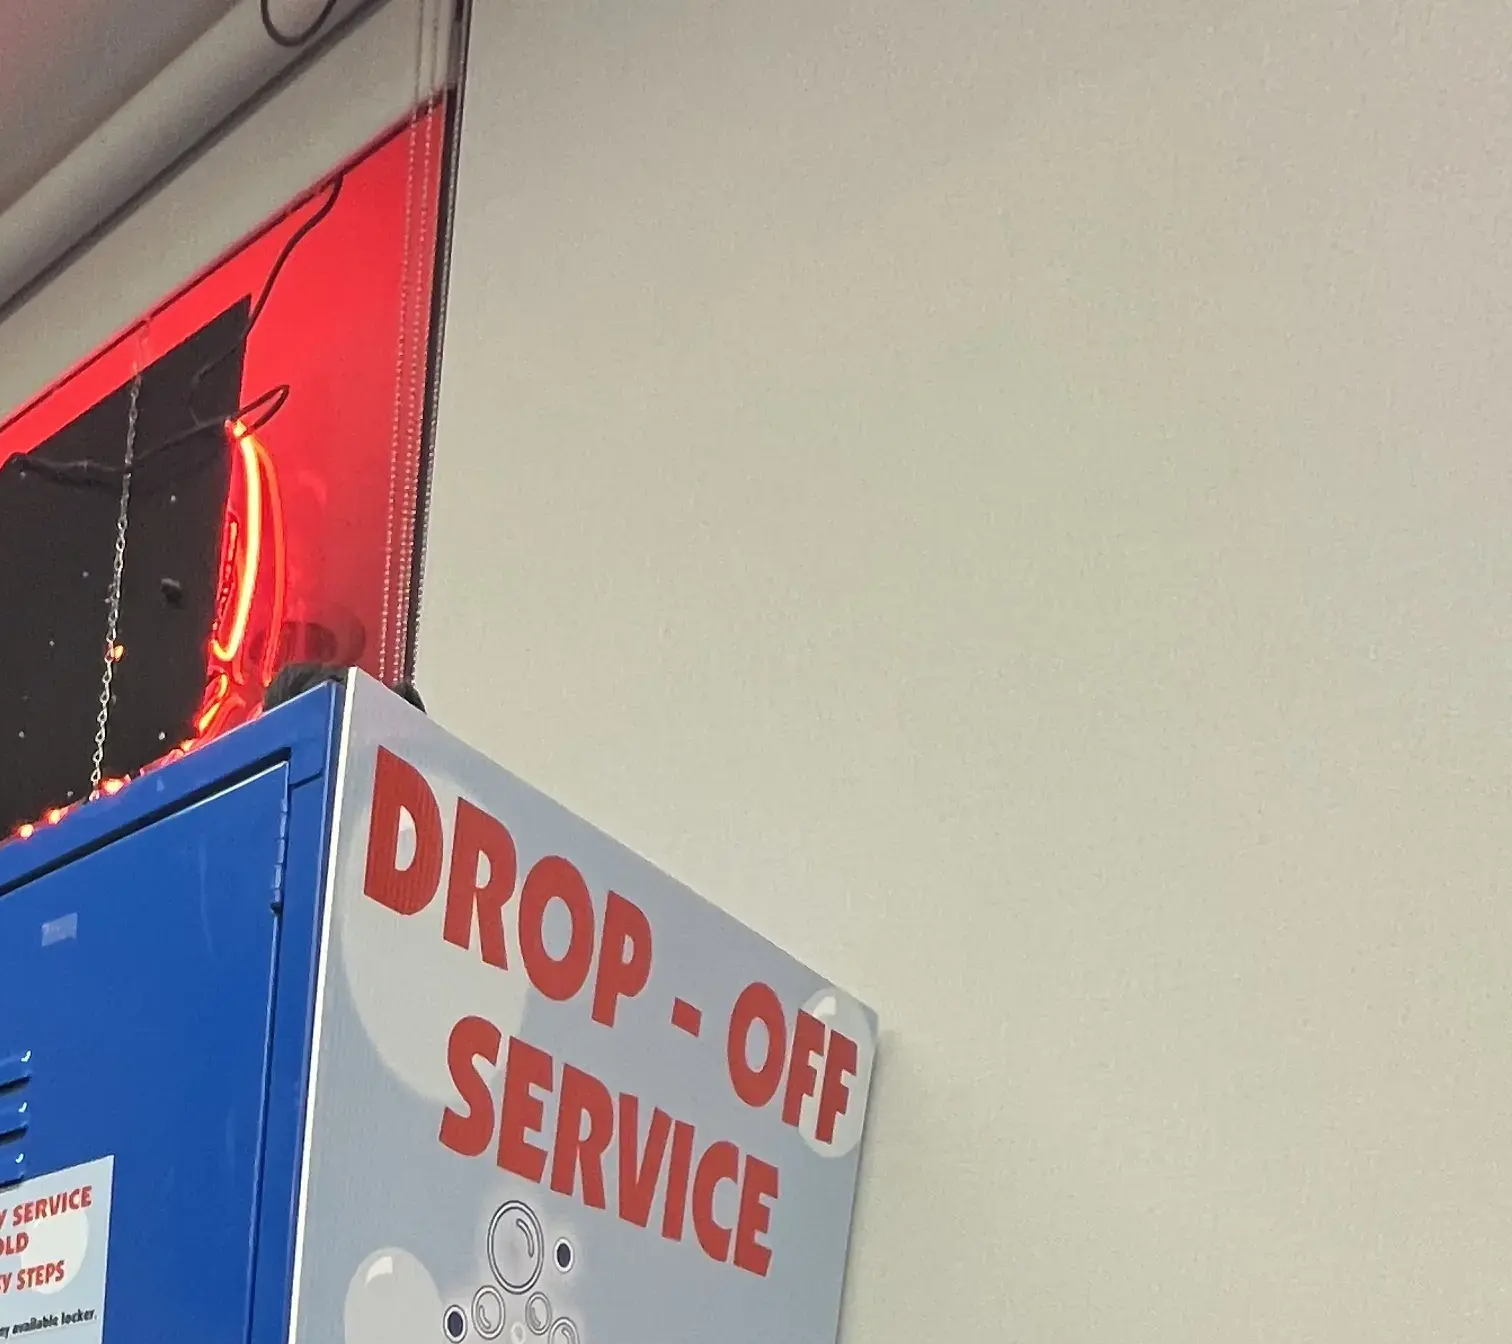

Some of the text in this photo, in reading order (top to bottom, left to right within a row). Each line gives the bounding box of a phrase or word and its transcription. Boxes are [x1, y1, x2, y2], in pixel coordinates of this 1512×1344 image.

[363, 744, 858, 1145] DROP - OFF
[438, 1015, 779, 1278] SERVICE
[13, 1186, 93, 1227] SERVICE
[17, 1259, 66, 1291] STEPS
[12, 1315, 59, 1334] available
[60, 1308, 98, 1325] locker.
